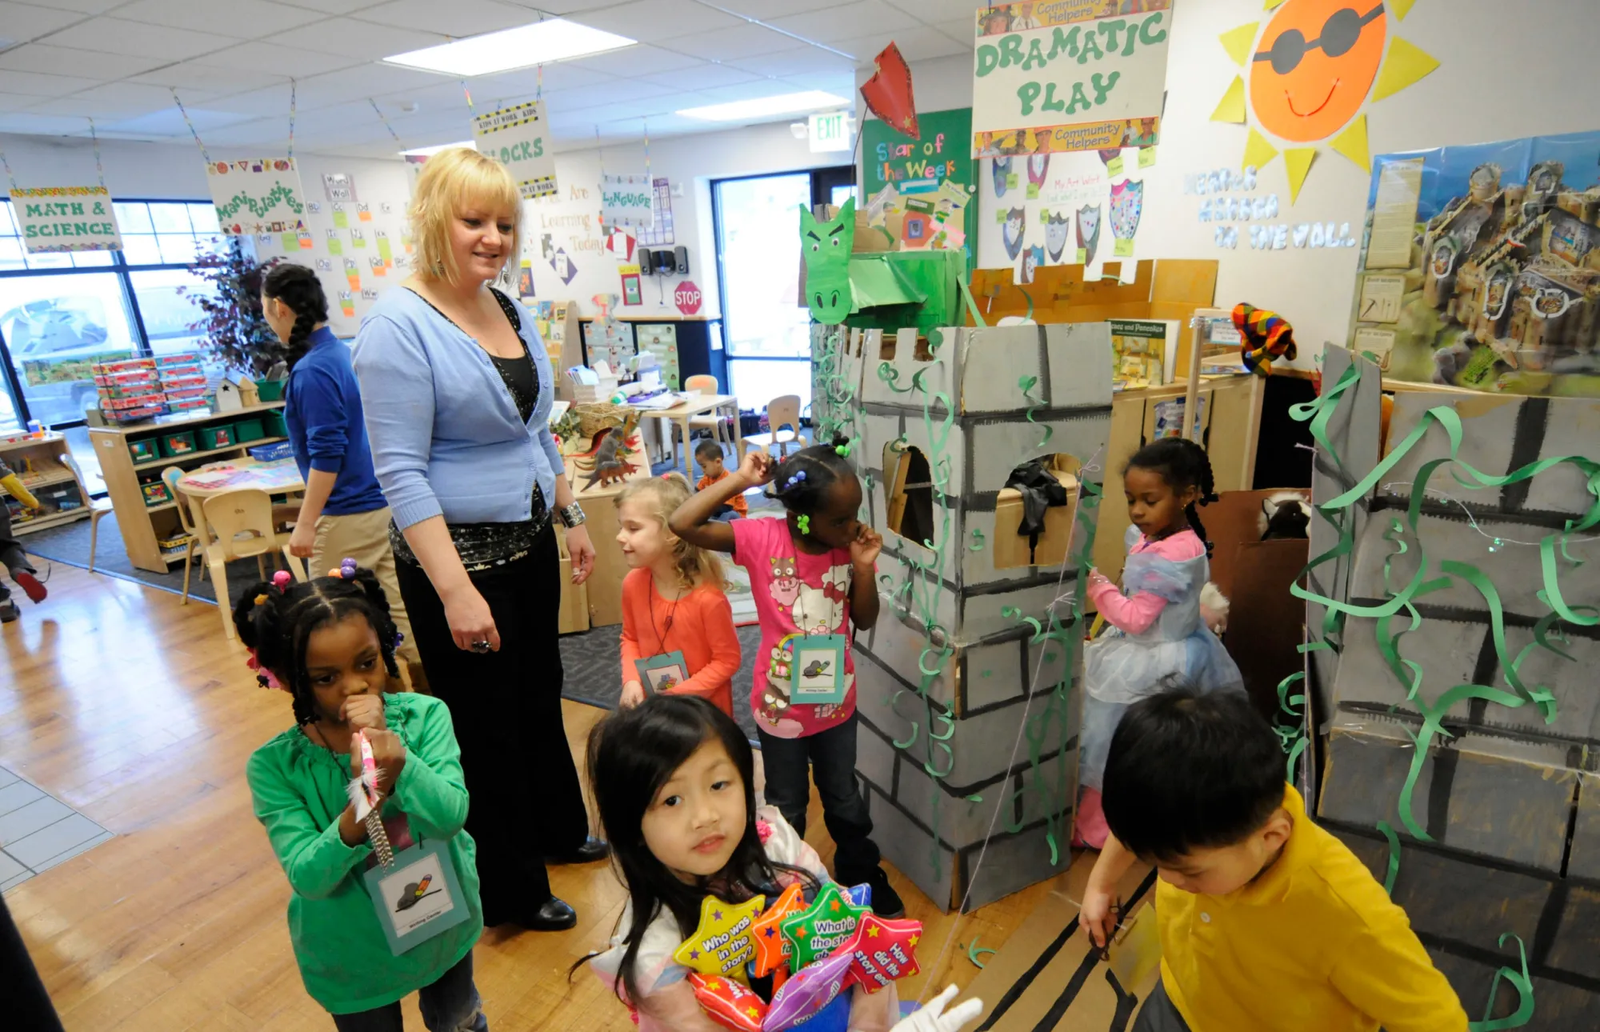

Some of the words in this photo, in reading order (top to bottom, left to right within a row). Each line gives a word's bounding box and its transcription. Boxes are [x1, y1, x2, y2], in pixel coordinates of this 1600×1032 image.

[1048, 7, 1094, 24] Helpers
[975, 12, 1167, 77] DRAMATIC
[1017, 71, 1121, 116] PLAY
[501, 113, 518, 123] WORK
[522, 107, 537, 118] KIDS
[816, 115, 842, 141] EXIT
[1055, 123, 1120, 140] Community
[483, 137, 544, 165] OCKS
[876, 141, 915, 161] Star
[923, 133, 945, 156] of
[1066, 135, 1110, 149] Helpers
[877, 162, 904, 181] the
[905, 159, 956, 179] Week
[217, 180, 303, 222] Manipulatives
[570, 184, 589, 201] Are
[602, 191, 651, 208] LANGUAGE
[26, 202, 86, 217] MATH
[92, 201, 106, 215] &
[25, 222, 115, 239] SCIENCE
[540, 213, 591, 231] Learning
[1248, 224, 1289, 250] THE
[1292, 222, 1357, 249] WALL
[674, 290, 701, 305] STOP
[702, 932, 730, 953] Who
[729, 915, 751, 936] was
[815, 920, 845, 934] What
[846, 916, 855, 930] is
[717, 949, 731, 961] in
[730, 935, 750, 953] the
[811, 937, 831, 949] the
[889, 942, 909, 965] How
[854, 950, 878, 975] story
[873, 950, 892, 967] did
[885, 962, 900, 978] the
